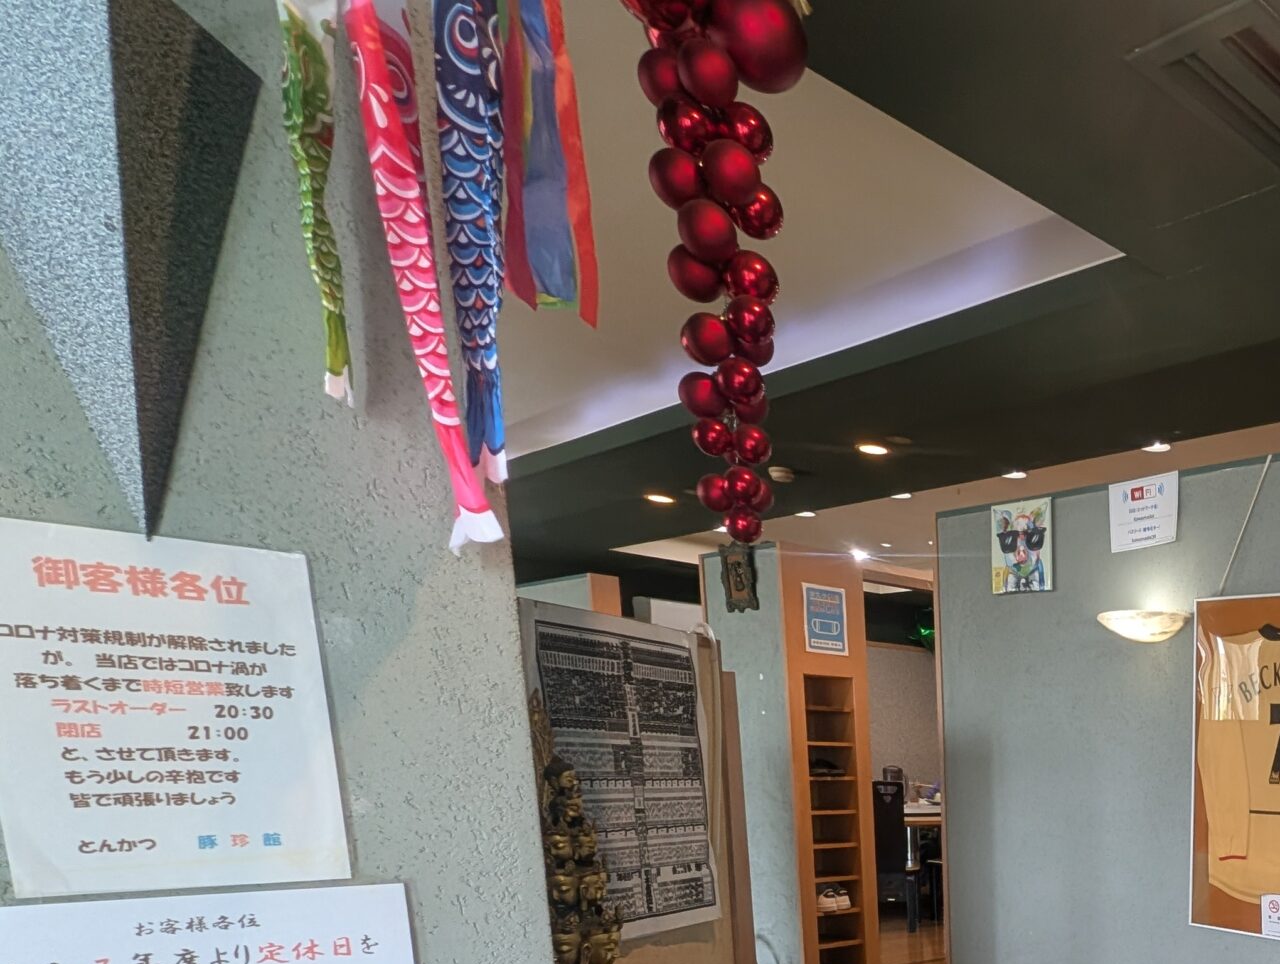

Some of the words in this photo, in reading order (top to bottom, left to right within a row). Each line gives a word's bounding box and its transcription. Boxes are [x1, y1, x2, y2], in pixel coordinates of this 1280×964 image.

[31, 555, 251, 606] 御客様各位
[0, 623, 297, 657] コロナ対策規制が解除されました
[14, 672, 296, 701] 落ち着くまで時短営業致します
[50, 697, 187, 717] ラストオーダー
[214, 703, 275, 721] 20:30
[55, 722, 103, 739] 閉店
[187, 725, 249, 742] 21:00
[60, 746, 241, 764] と、させて頂きます。
[64, 769, 242, 786] もう少しの辛抱です
[69, 791, 238, 808] 皆で頑張りましょう
[78, 837, 157, 855] とんかつ
[133, 912, 262, 937] お客様各位
